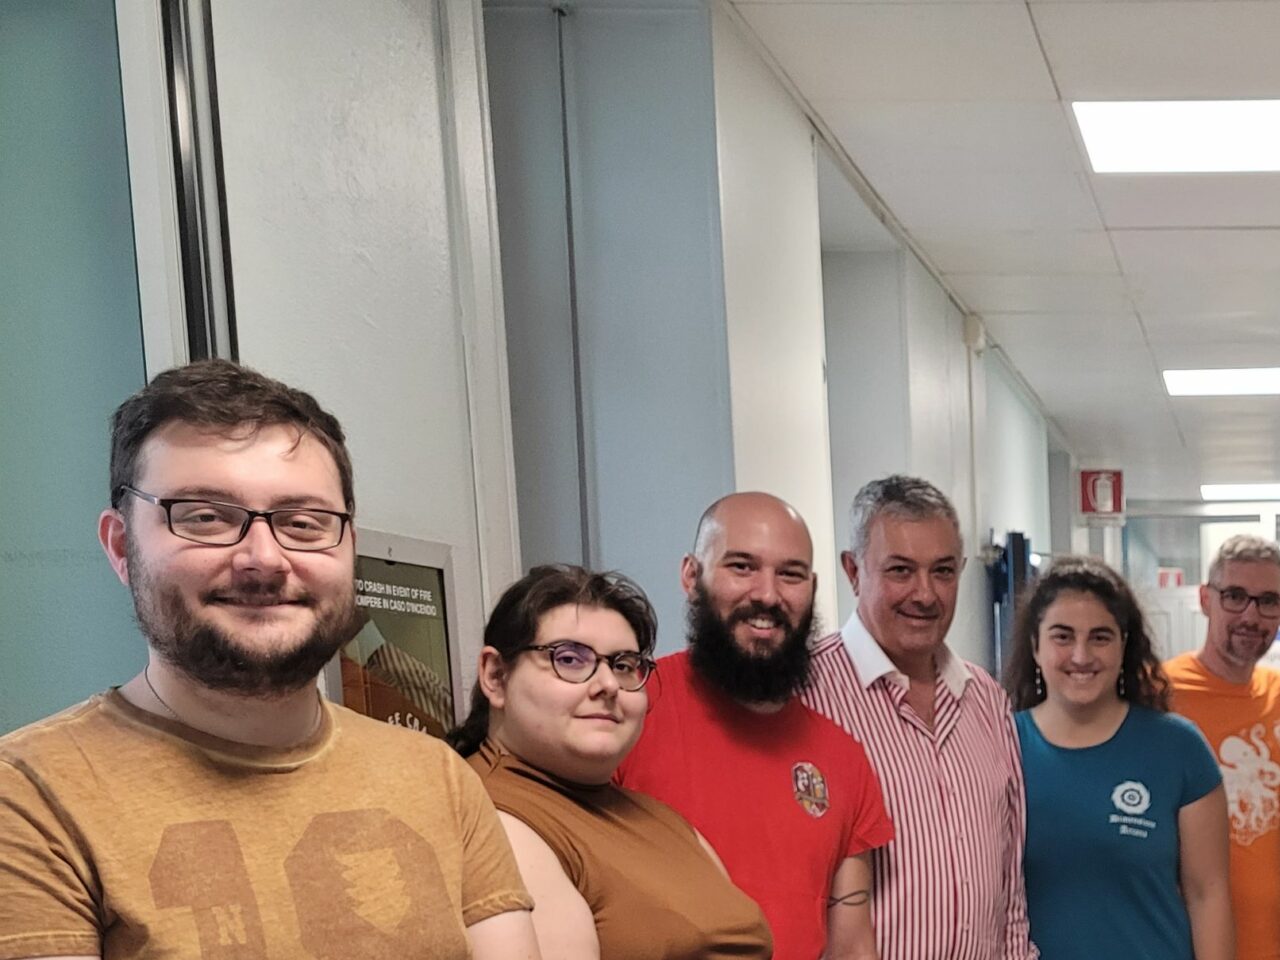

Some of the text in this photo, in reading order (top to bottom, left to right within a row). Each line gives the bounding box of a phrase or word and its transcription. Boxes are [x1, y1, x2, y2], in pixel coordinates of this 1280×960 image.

[393, 585, 410, 598] EVENT
[411, 588, 419, 600] OF
[356, 594, 382, 608] OMPERE
